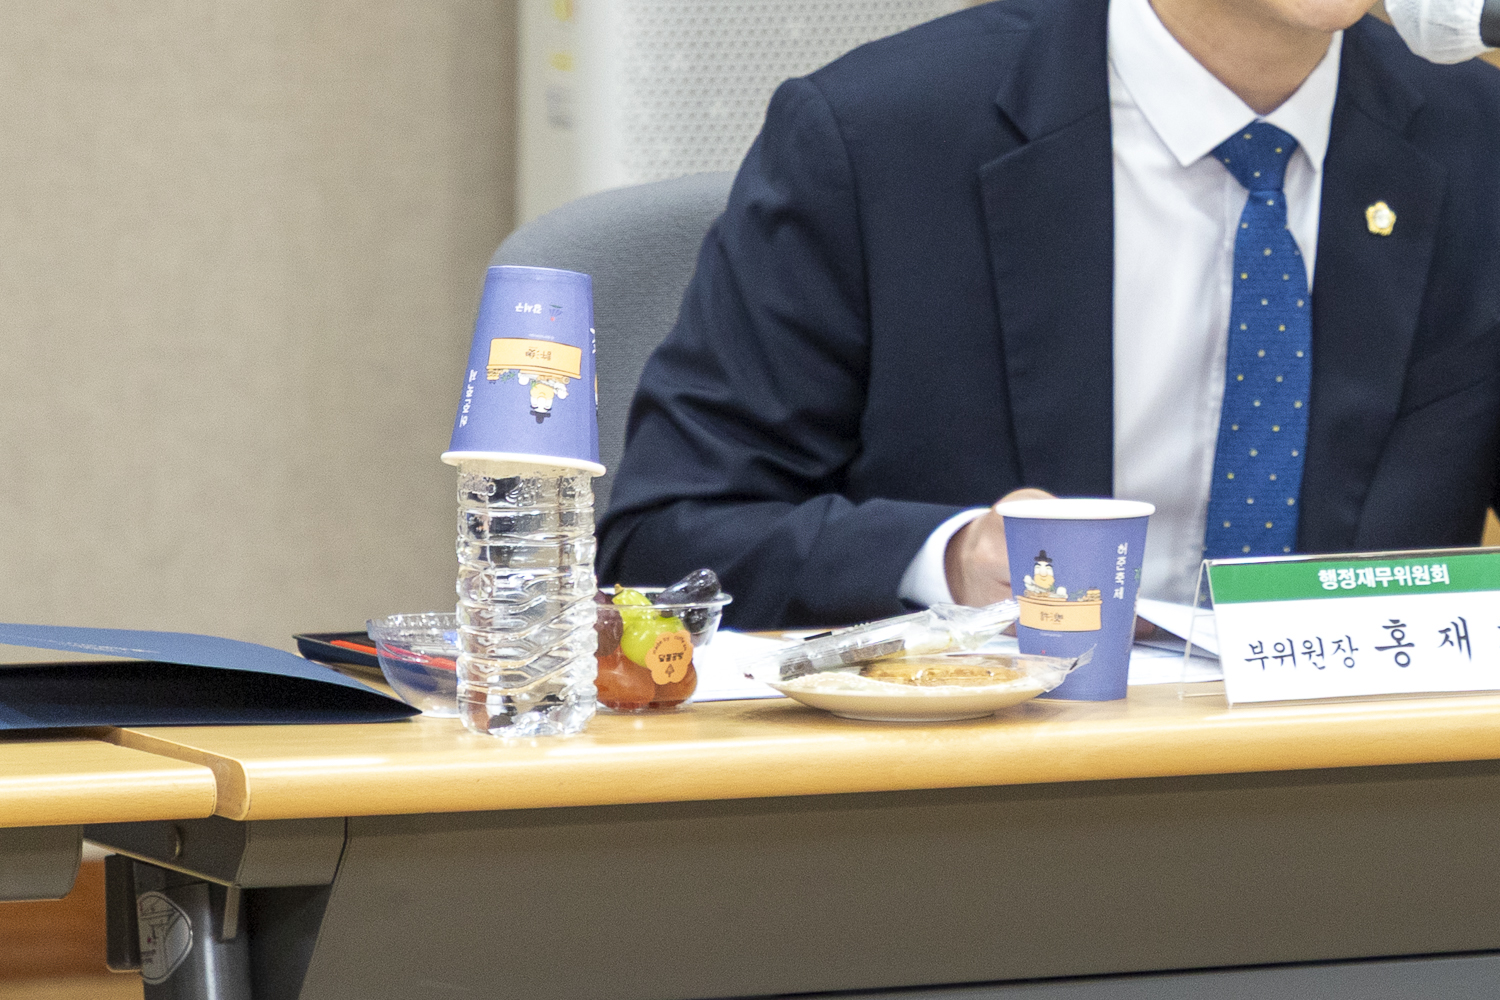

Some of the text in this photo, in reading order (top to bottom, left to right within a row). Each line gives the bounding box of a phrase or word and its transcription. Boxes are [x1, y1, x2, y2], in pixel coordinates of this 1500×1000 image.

[514, 302, 543, 315] 강서구
[1113, 542, 1128, 600] 허준축제
[1317, 562, 1451, 592] 행정재무위원회
[1243, 633, 1360, 671] 부위원장
[1373, 617, 1416, 669] 홍
[1436, 615, 1473, 662] 재
